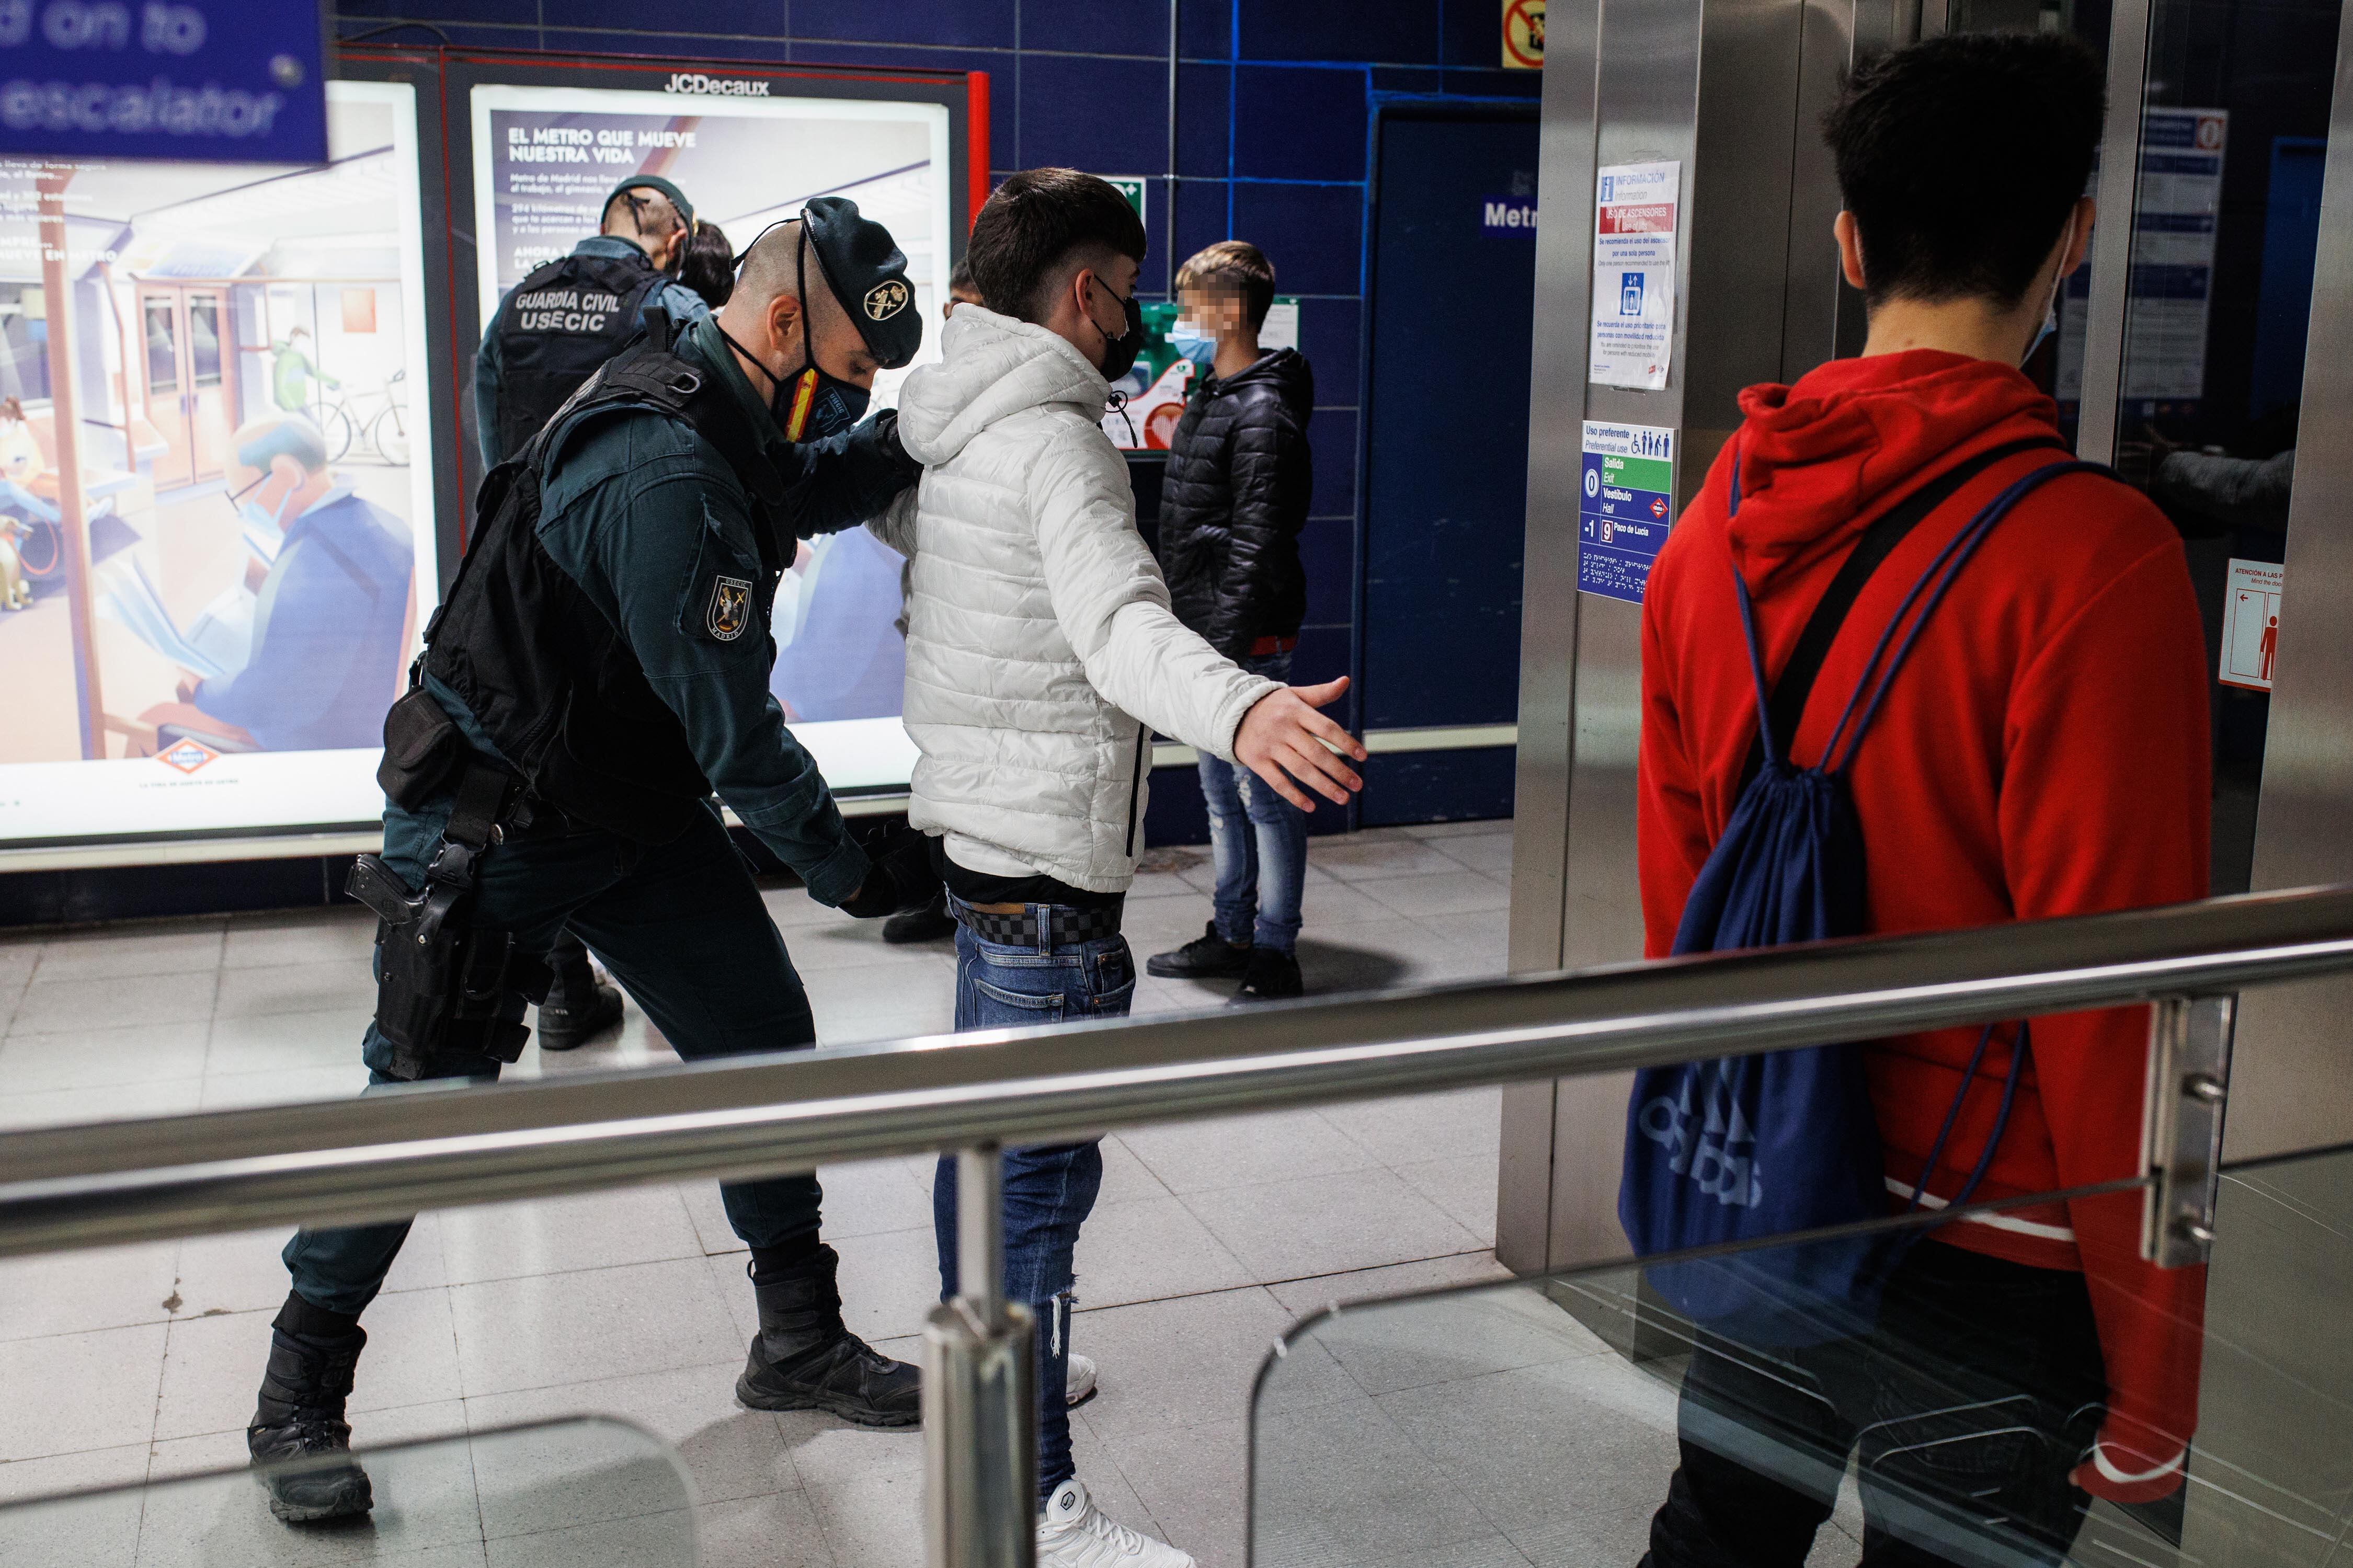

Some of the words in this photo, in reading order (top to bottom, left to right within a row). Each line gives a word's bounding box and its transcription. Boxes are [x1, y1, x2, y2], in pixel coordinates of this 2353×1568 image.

[141, 1, 207, 55] to
[664, 74, 769, 96] JCDecaux
[0, 77, 284, 136] escalator
[509, 128, 529, 144] EL
[533, 129, 593, 145] METRO
[597, 130, 634, 147] QUE
[638, 132, 696, 147] MUEVE
[509, 146, 589, 163] NUESTRA
[592, 147, 635, 164] VIDA
[510, 174, 535, 182] Metro
[537, 174, 549, 183] de
[551, 174, 580, 183] Madrid
[1616, 171, 1665, 186] INFORMACIÓN
[1606, 208, 1618, 219] USO
[1618, 208, 1626, 218] DE
[1627, 207, 1666, 218] ASCENSORES
[45, 250, 65, 261] EN
[514, 246, 558, 257] AHORA
[516, 291, 578, 310] GUARDIA
[582, 293, 620, 313] CIVIL
[520, 310, 606, 332] USECIC
[829, 393, 845, 414] USECIC
[1586, 425, 1597, 435] Uso
[1599, 427, 1629, 439] preferente
[1585, 440, 1616, 452] Preferential
[1604, 457, 1624, 470] Salida
[1589, 475, 1595, 491] 0
[1604, 472, 1615, 483] Exit
[1603, 487, 1632, 502] Vestíbulo
[1602, 502, 1615, 514] Hall
[1584, 520, 1594, 537] -1
[1604, 523, 1610, 540] 9
[1614, 522, 1626, 533] Paco
[1635, 527, 1649, 536] Lucía
[2235, 568, 2261, 576] ATENCIÓN
[726, 578, 747, 587] USECIC
[711, 627, 739, 639] MADRID
